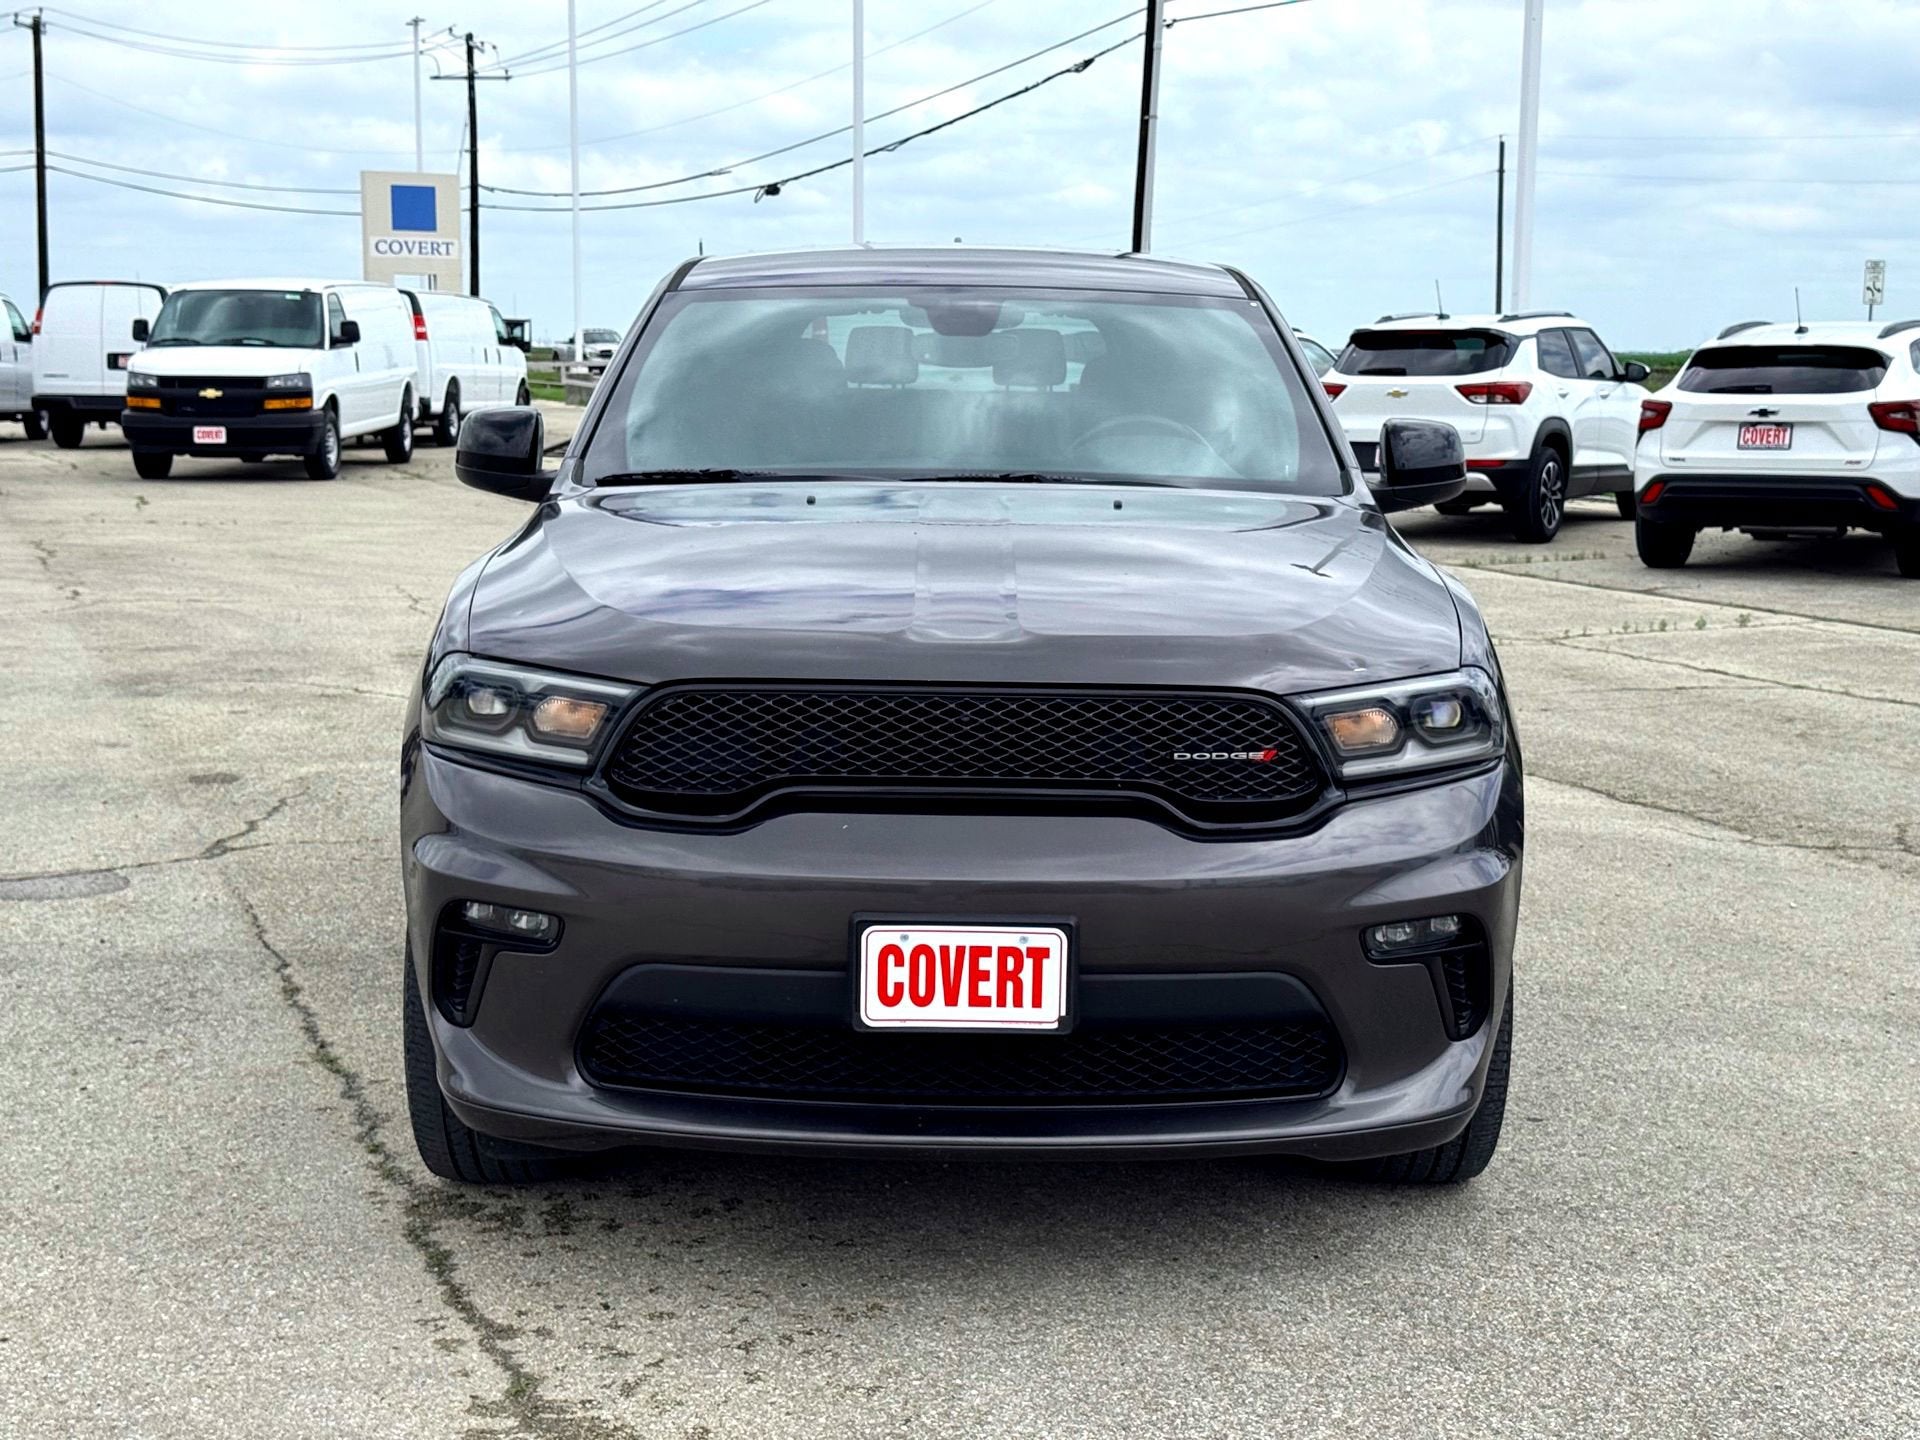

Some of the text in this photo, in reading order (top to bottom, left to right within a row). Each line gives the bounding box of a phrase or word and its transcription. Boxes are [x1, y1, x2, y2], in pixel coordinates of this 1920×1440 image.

[375, 239, 454, 256] COVERT
[1743, 426, 1788, 445] COVERT
[1173, 752, 1265, 760] DODGE
[877, 943, 1050, 1008] COVERT
